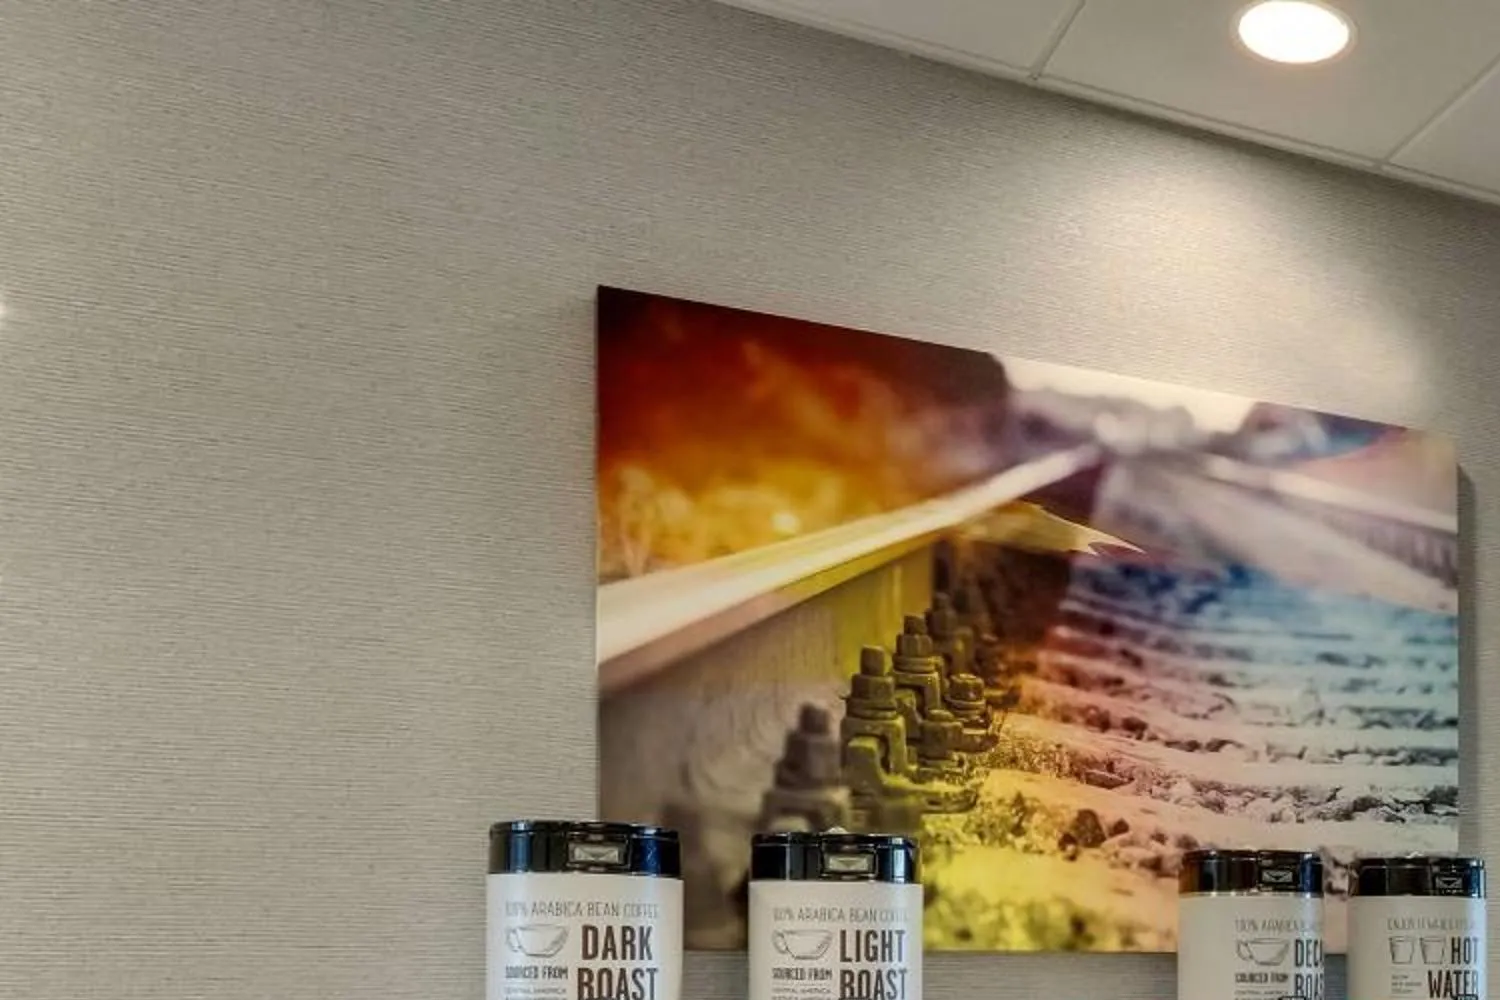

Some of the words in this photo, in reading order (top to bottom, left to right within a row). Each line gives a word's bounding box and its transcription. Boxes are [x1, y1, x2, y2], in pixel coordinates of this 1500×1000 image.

[531, 902, 583, 917] ARABICA
[587, 902, 619, 917] BEAN
[797, 907, 845, 922] ARABICA
[849, 908, 877, 923] BEAN
[581, 923, 653, 961] DARK
[839, 929, 906, 963] LIGHT
[1451, 936, 1479, 965] HOT
[542, 965, 569, 980] FROM
[808, 967, 833, 981] FROM
[1427, 969, 1479, 999] WATER
